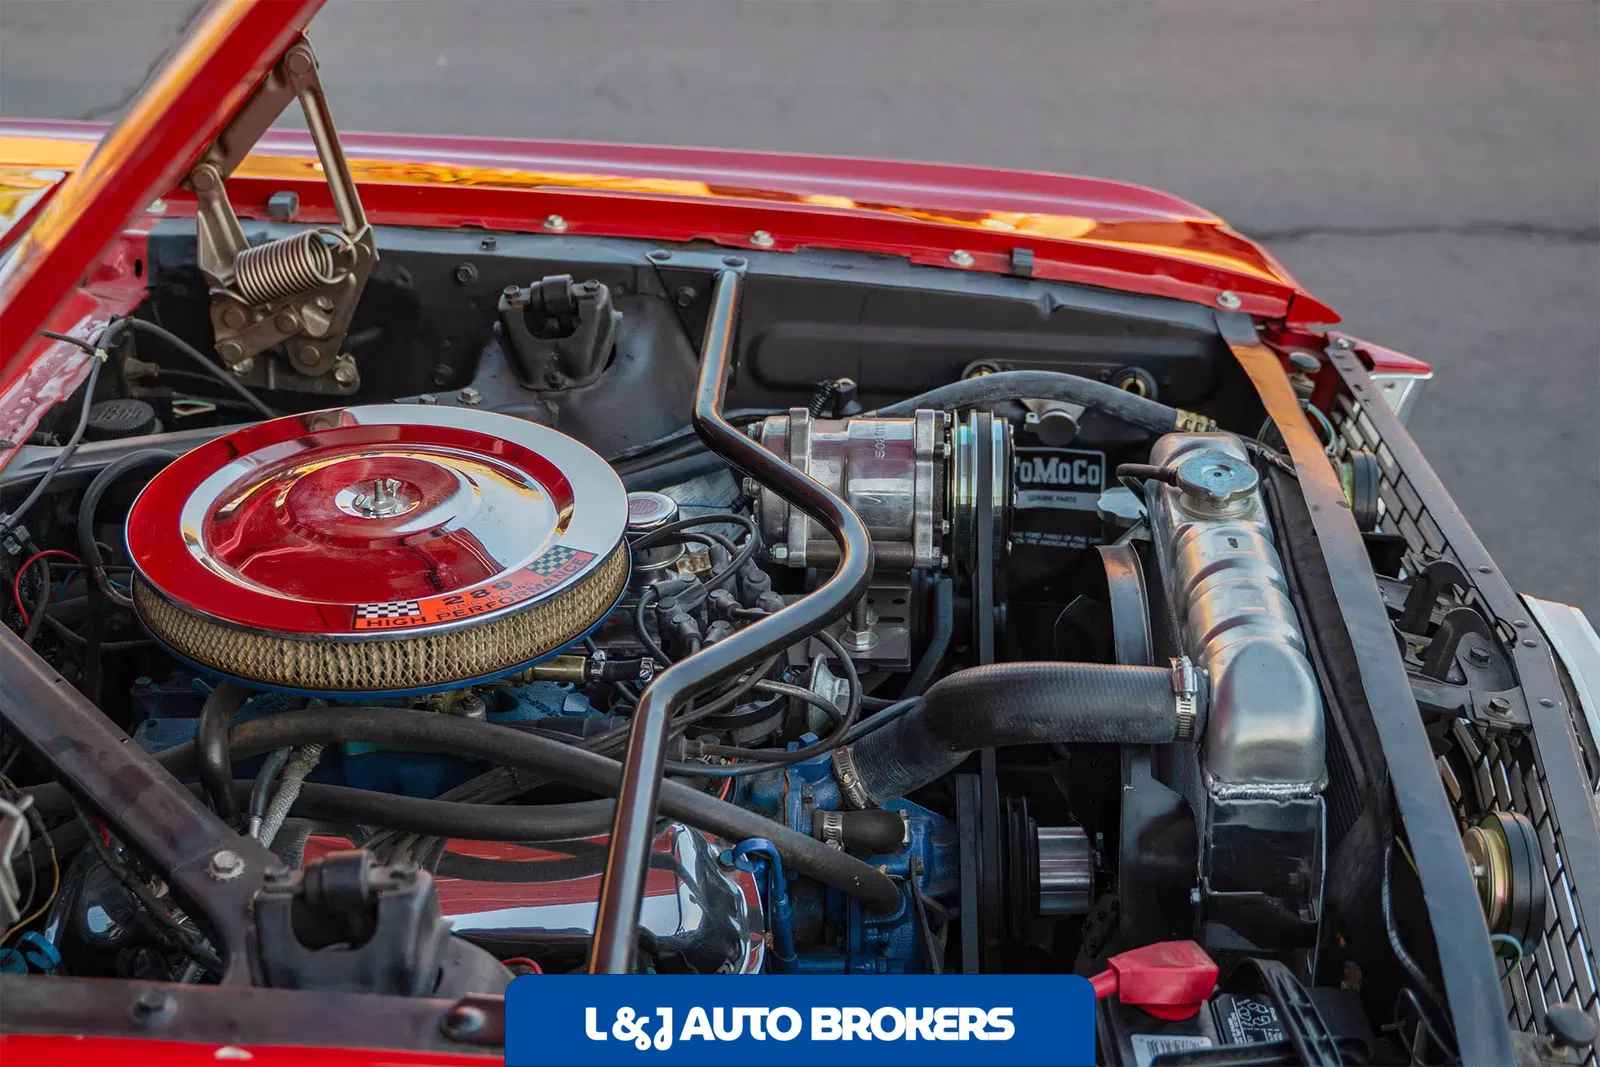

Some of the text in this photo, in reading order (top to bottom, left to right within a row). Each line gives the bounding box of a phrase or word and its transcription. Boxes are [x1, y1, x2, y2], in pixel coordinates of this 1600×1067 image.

[366, 558, 583, 628] HIGH PERFORMANCE
[442, 581, 513, 606] 289
